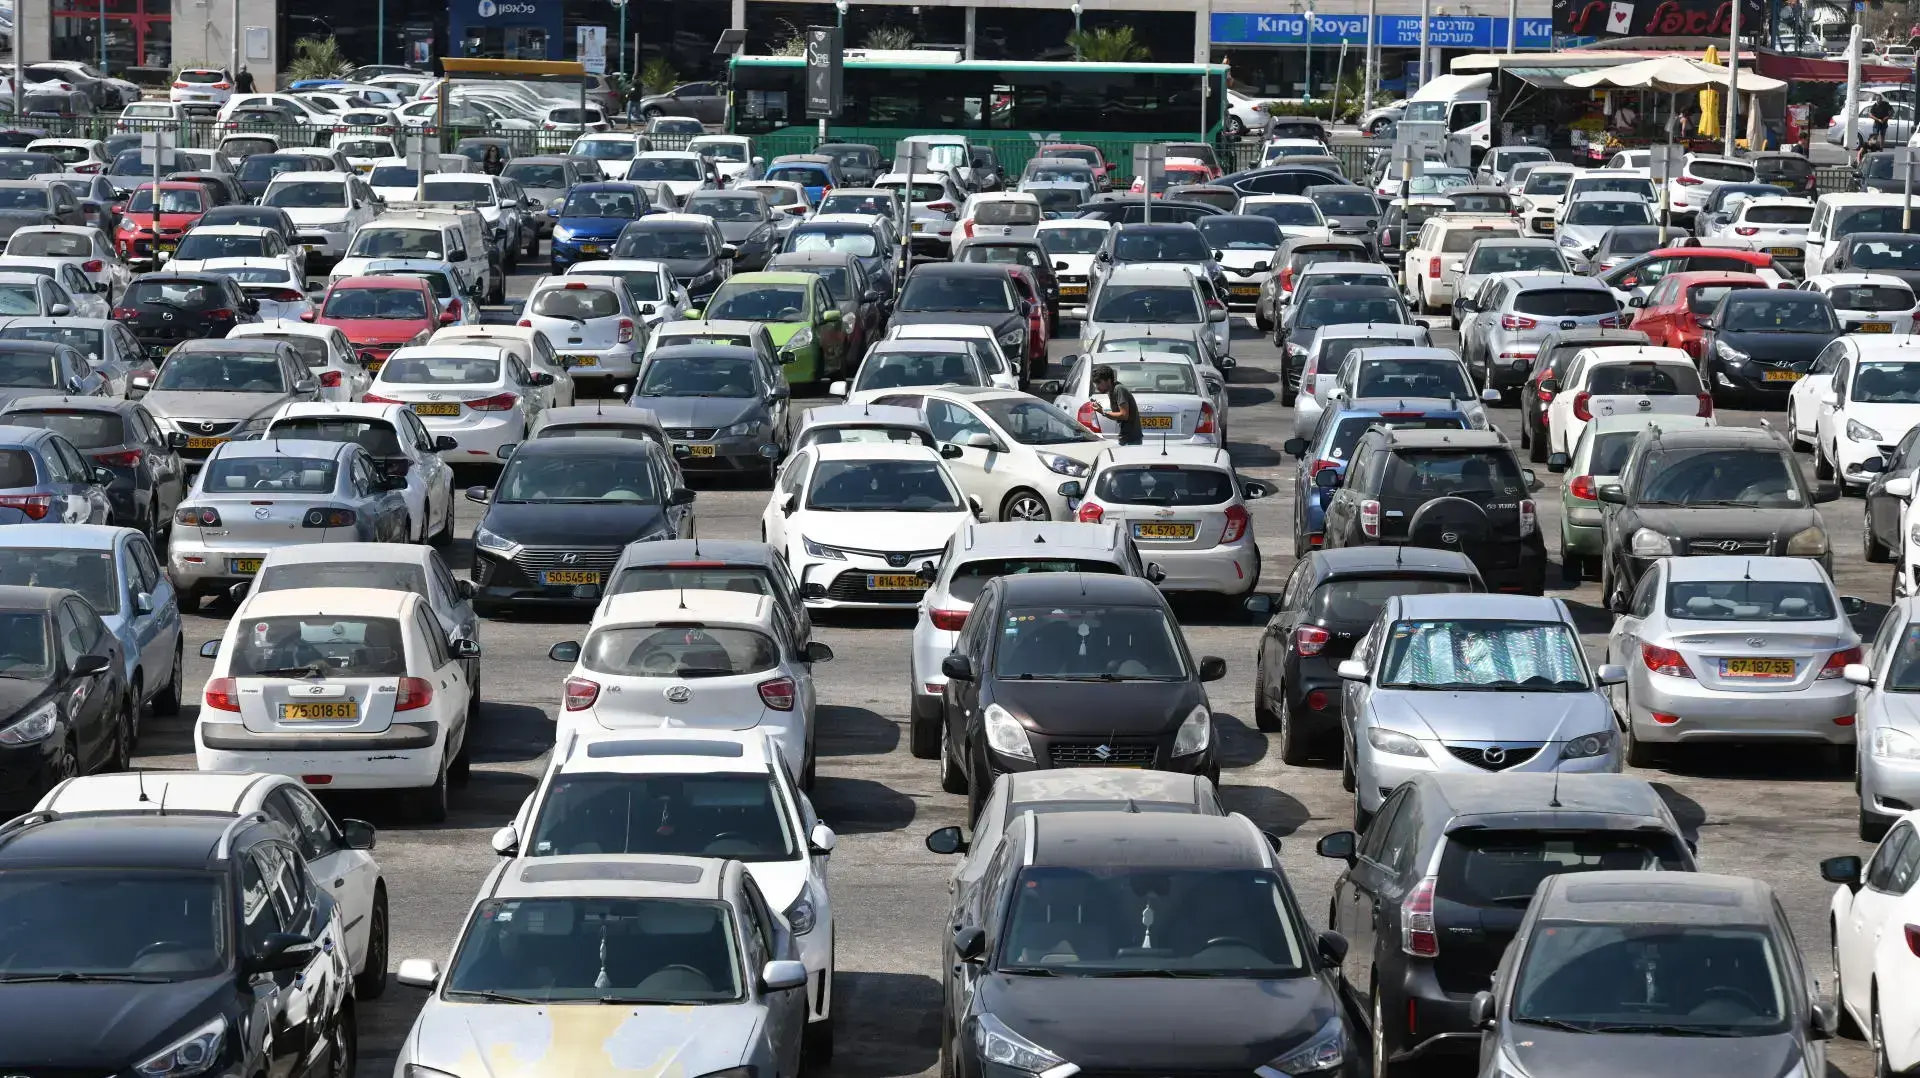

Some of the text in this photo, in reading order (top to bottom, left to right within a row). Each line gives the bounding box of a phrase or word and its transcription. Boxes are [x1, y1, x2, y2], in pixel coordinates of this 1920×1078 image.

[498, 3, 536, 16] פלאפון
[1257, 16, 1368, 36] King Royal
[1437, 20, 1475, 32] מזרנים
[1428, 31, 1474, 43] מערכות
